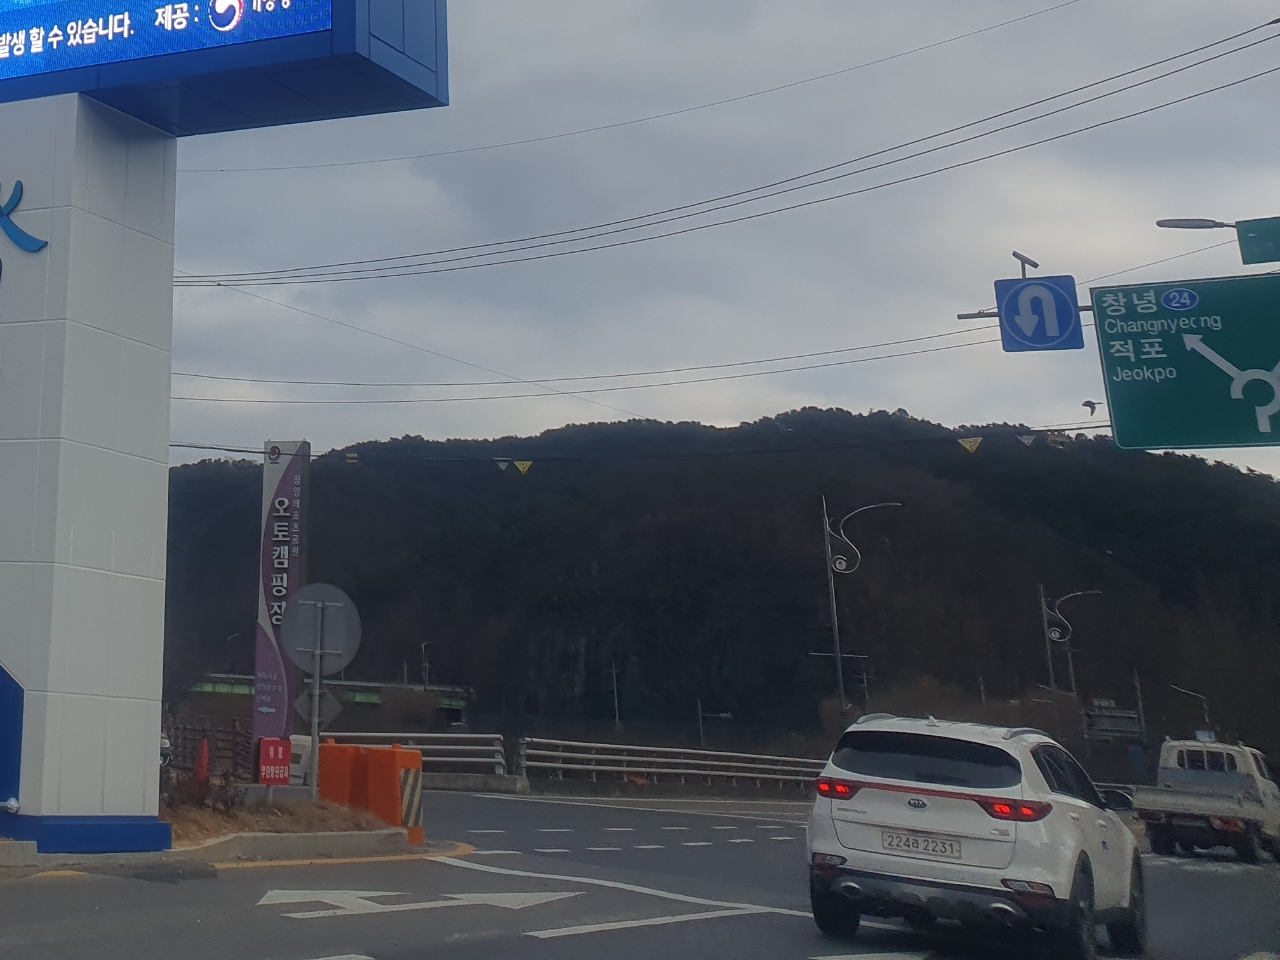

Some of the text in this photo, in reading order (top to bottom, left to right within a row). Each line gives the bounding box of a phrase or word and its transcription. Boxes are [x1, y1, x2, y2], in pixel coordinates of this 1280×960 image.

[154, 3, 190, 31] 제공
[29, 25, 46, 54] 할
[47, 25, 64, 50] 수
[66, 11, 134, 46] 있습니다.
[1102, 290, 1191, 316] 창녕 24
[1108, 338, 1167, 362] 적포
[1112, 365, 1177, 383] Jeokpo
[269, 497, 291, 625] 오토캠핑장
[923, 839, 955, 855] 2231
